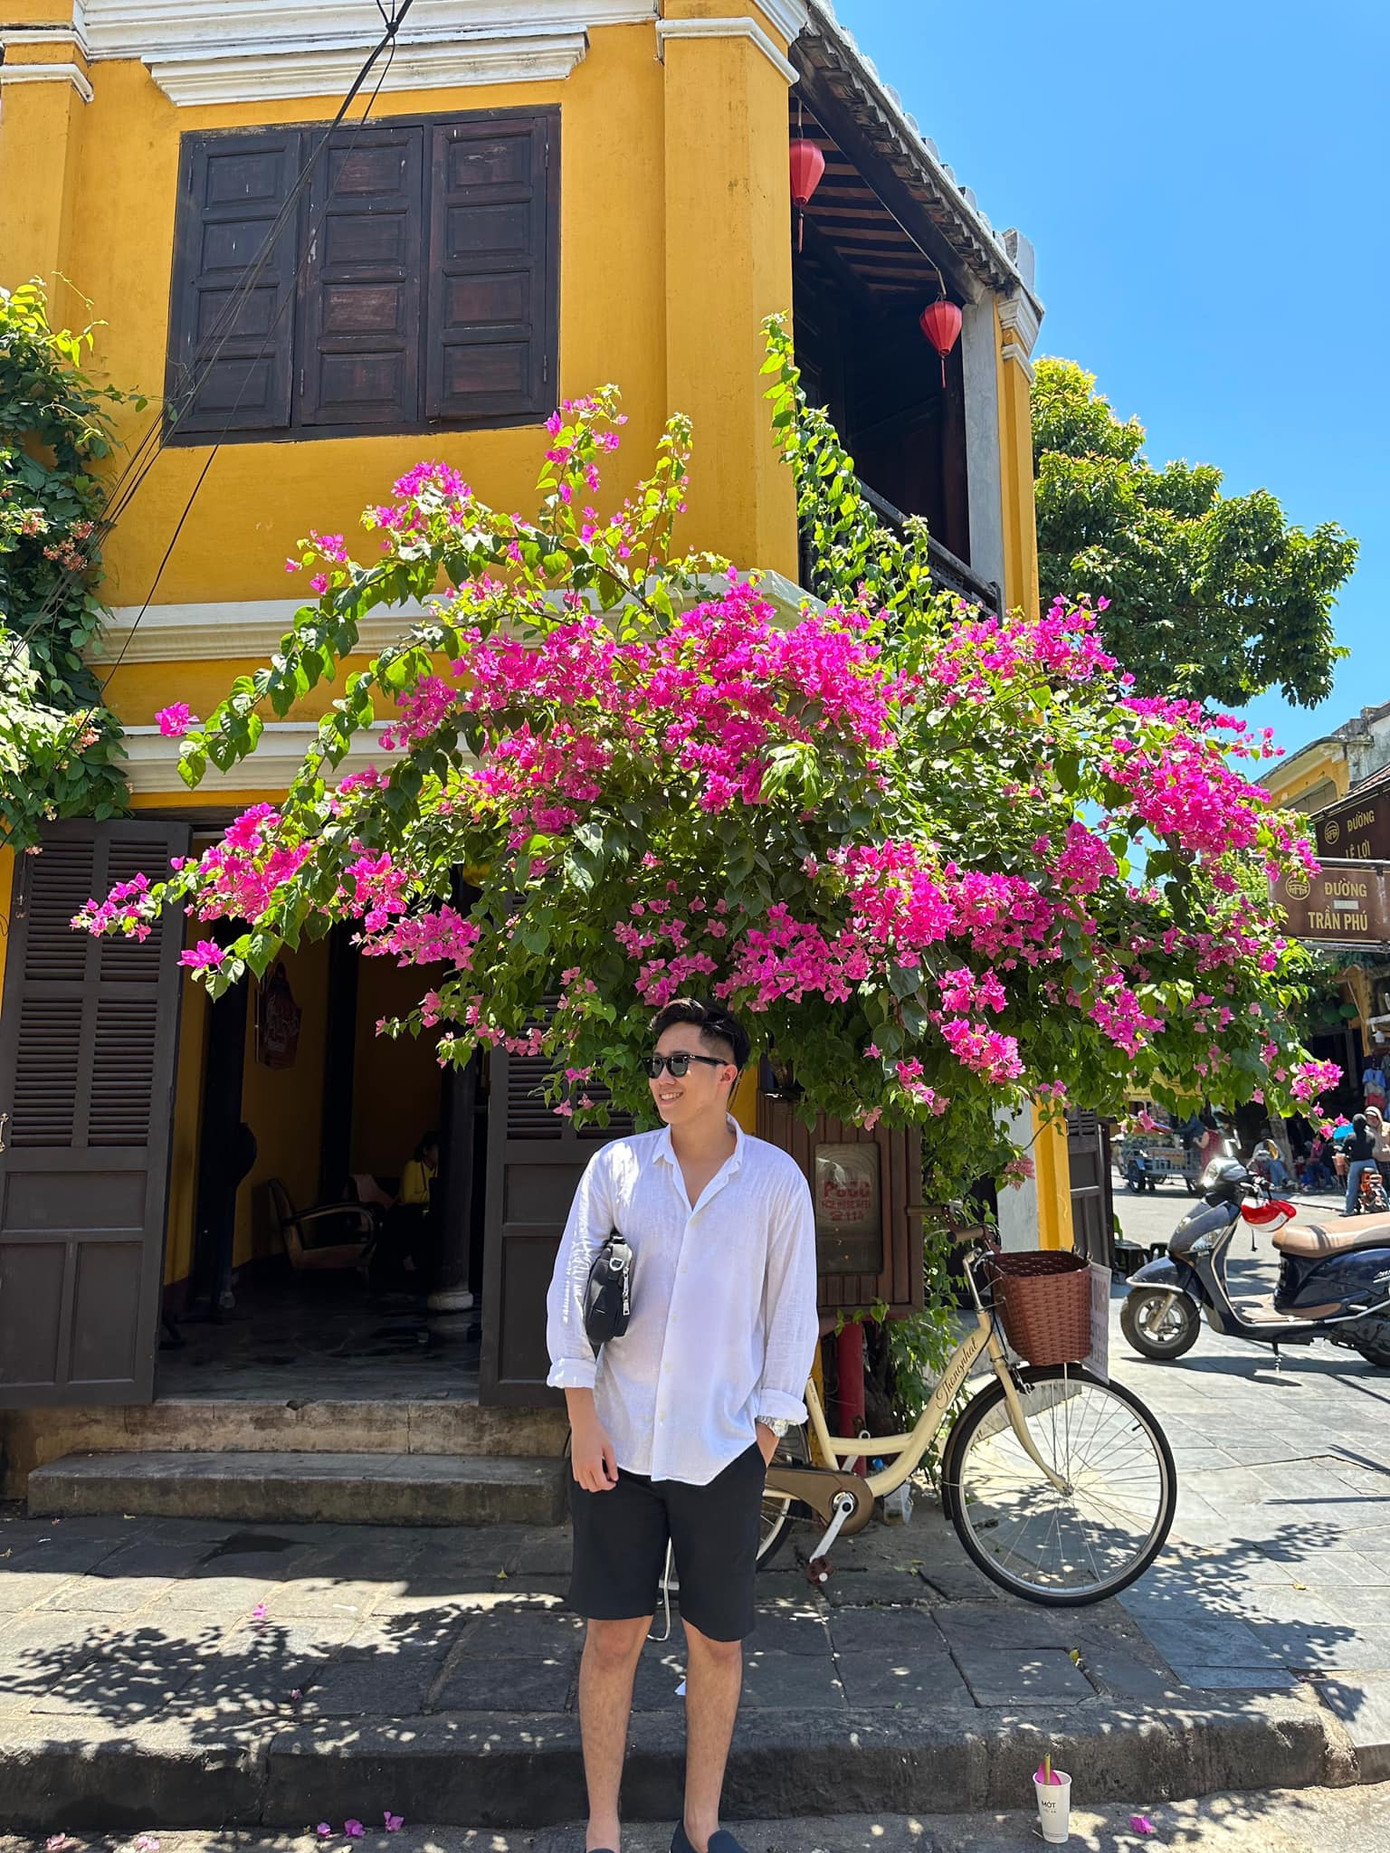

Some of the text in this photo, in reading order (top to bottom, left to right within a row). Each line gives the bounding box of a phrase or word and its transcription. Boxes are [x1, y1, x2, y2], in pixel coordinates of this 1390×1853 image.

[1347, 810, 1375, 832] ĐƯỜNG
[1324, 878, 1367, 897] ĐƯỜNG
[1308, 905, 1341, 930] TRẦN
[1344, 910, 1368, 931] PHÚ
